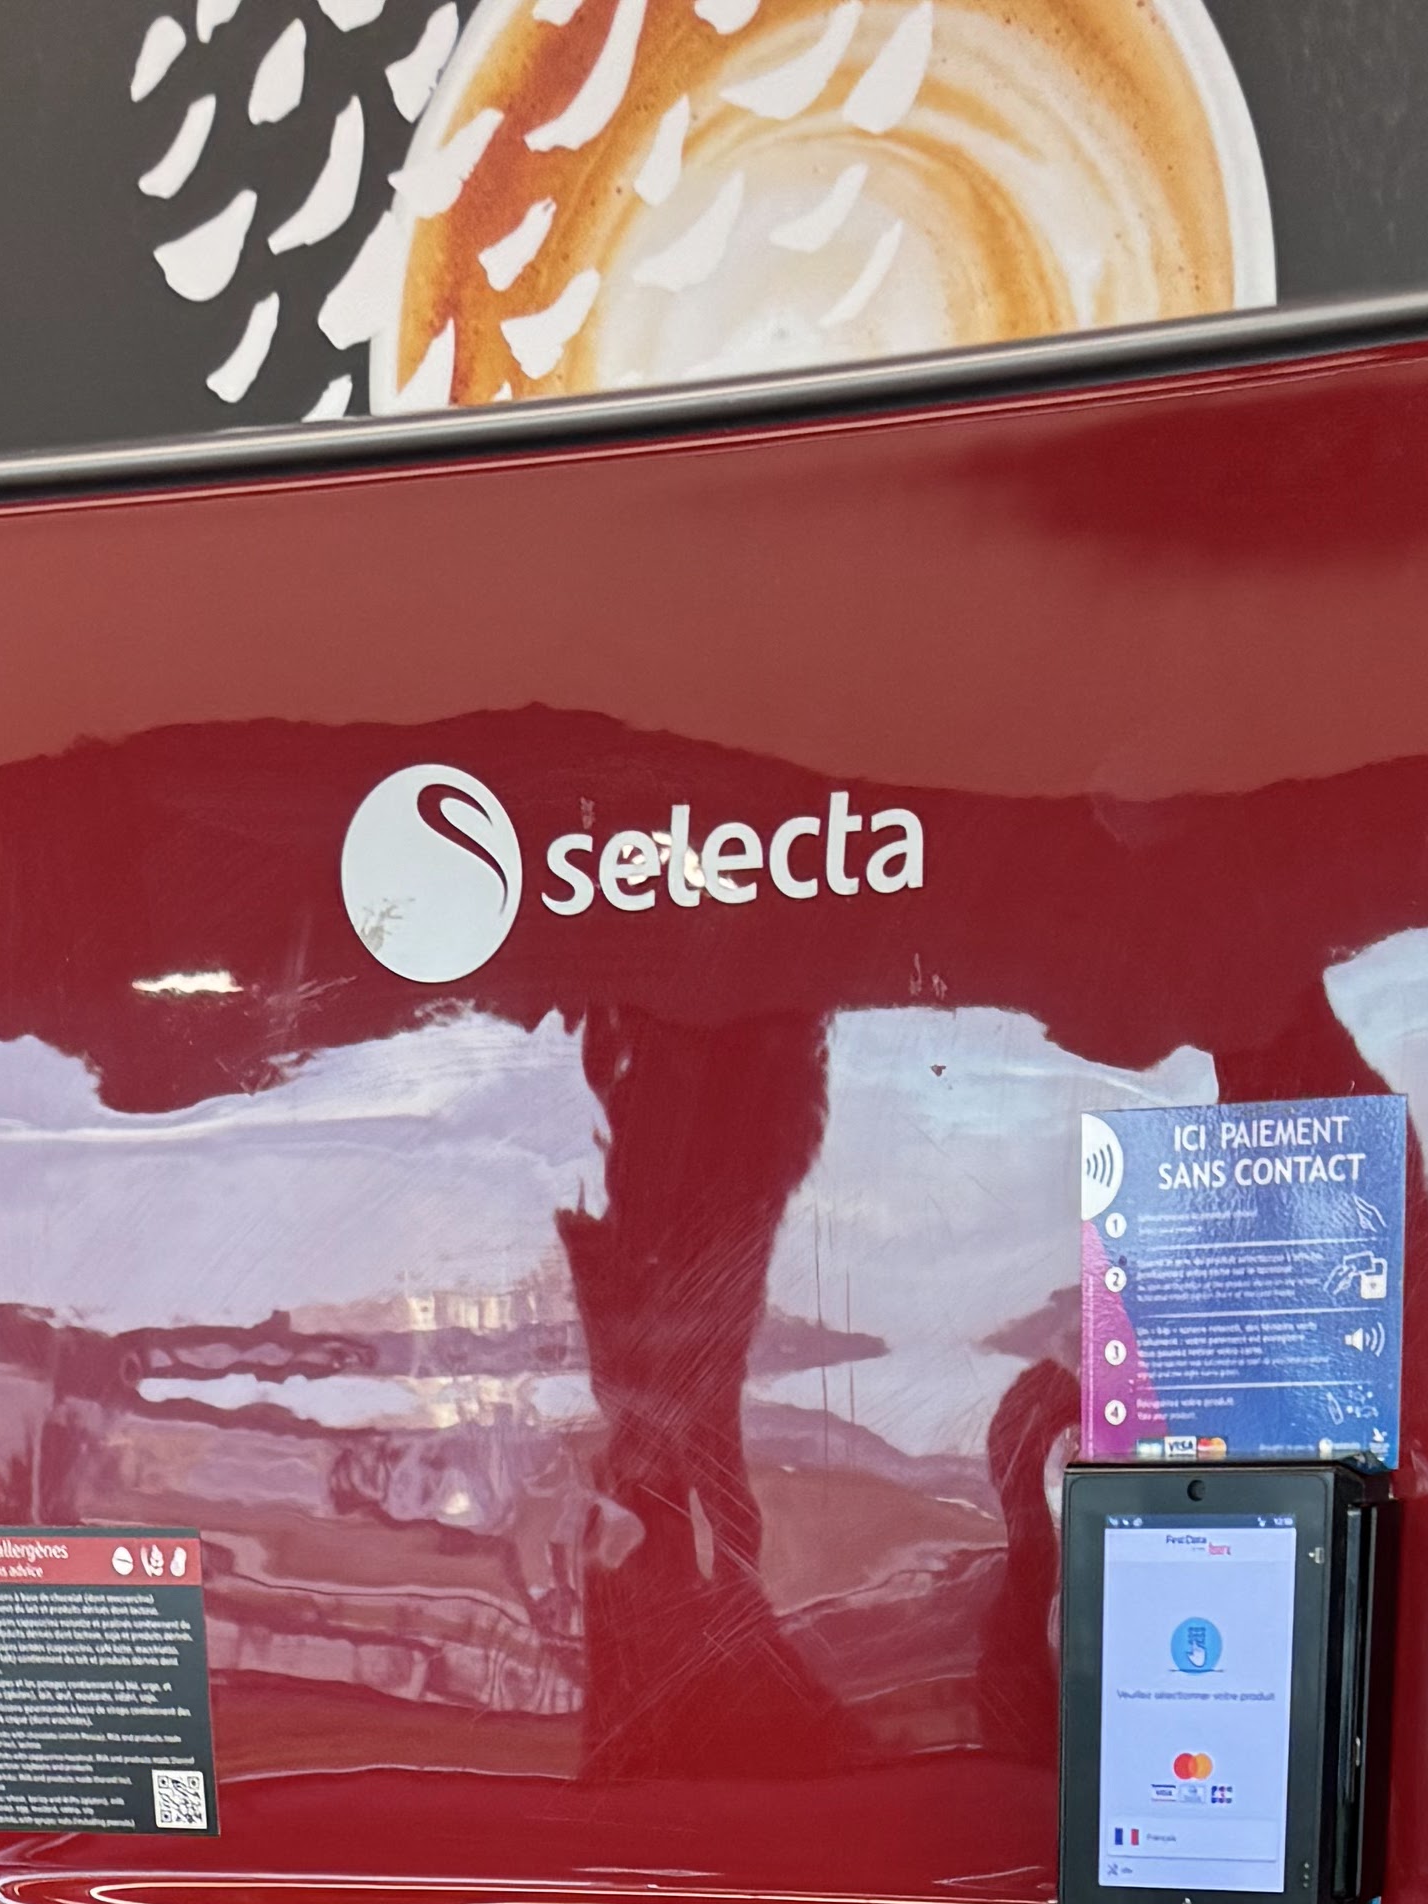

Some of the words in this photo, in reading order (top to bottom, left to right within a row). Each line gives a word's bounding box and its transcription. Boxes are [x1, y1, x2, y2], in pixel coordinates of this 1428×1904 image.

[541, 791, 924, 916] selecta
[1174, 1125, 1206, 1152] ICI
[1221, 1115, 1349, 1149] PAIEMENT
[1159, 1162, 1226, 1190] SANS
[1234, 1153, 1366, 1186] CONTACT
[1111, 1272, 1120, 1287] 2
